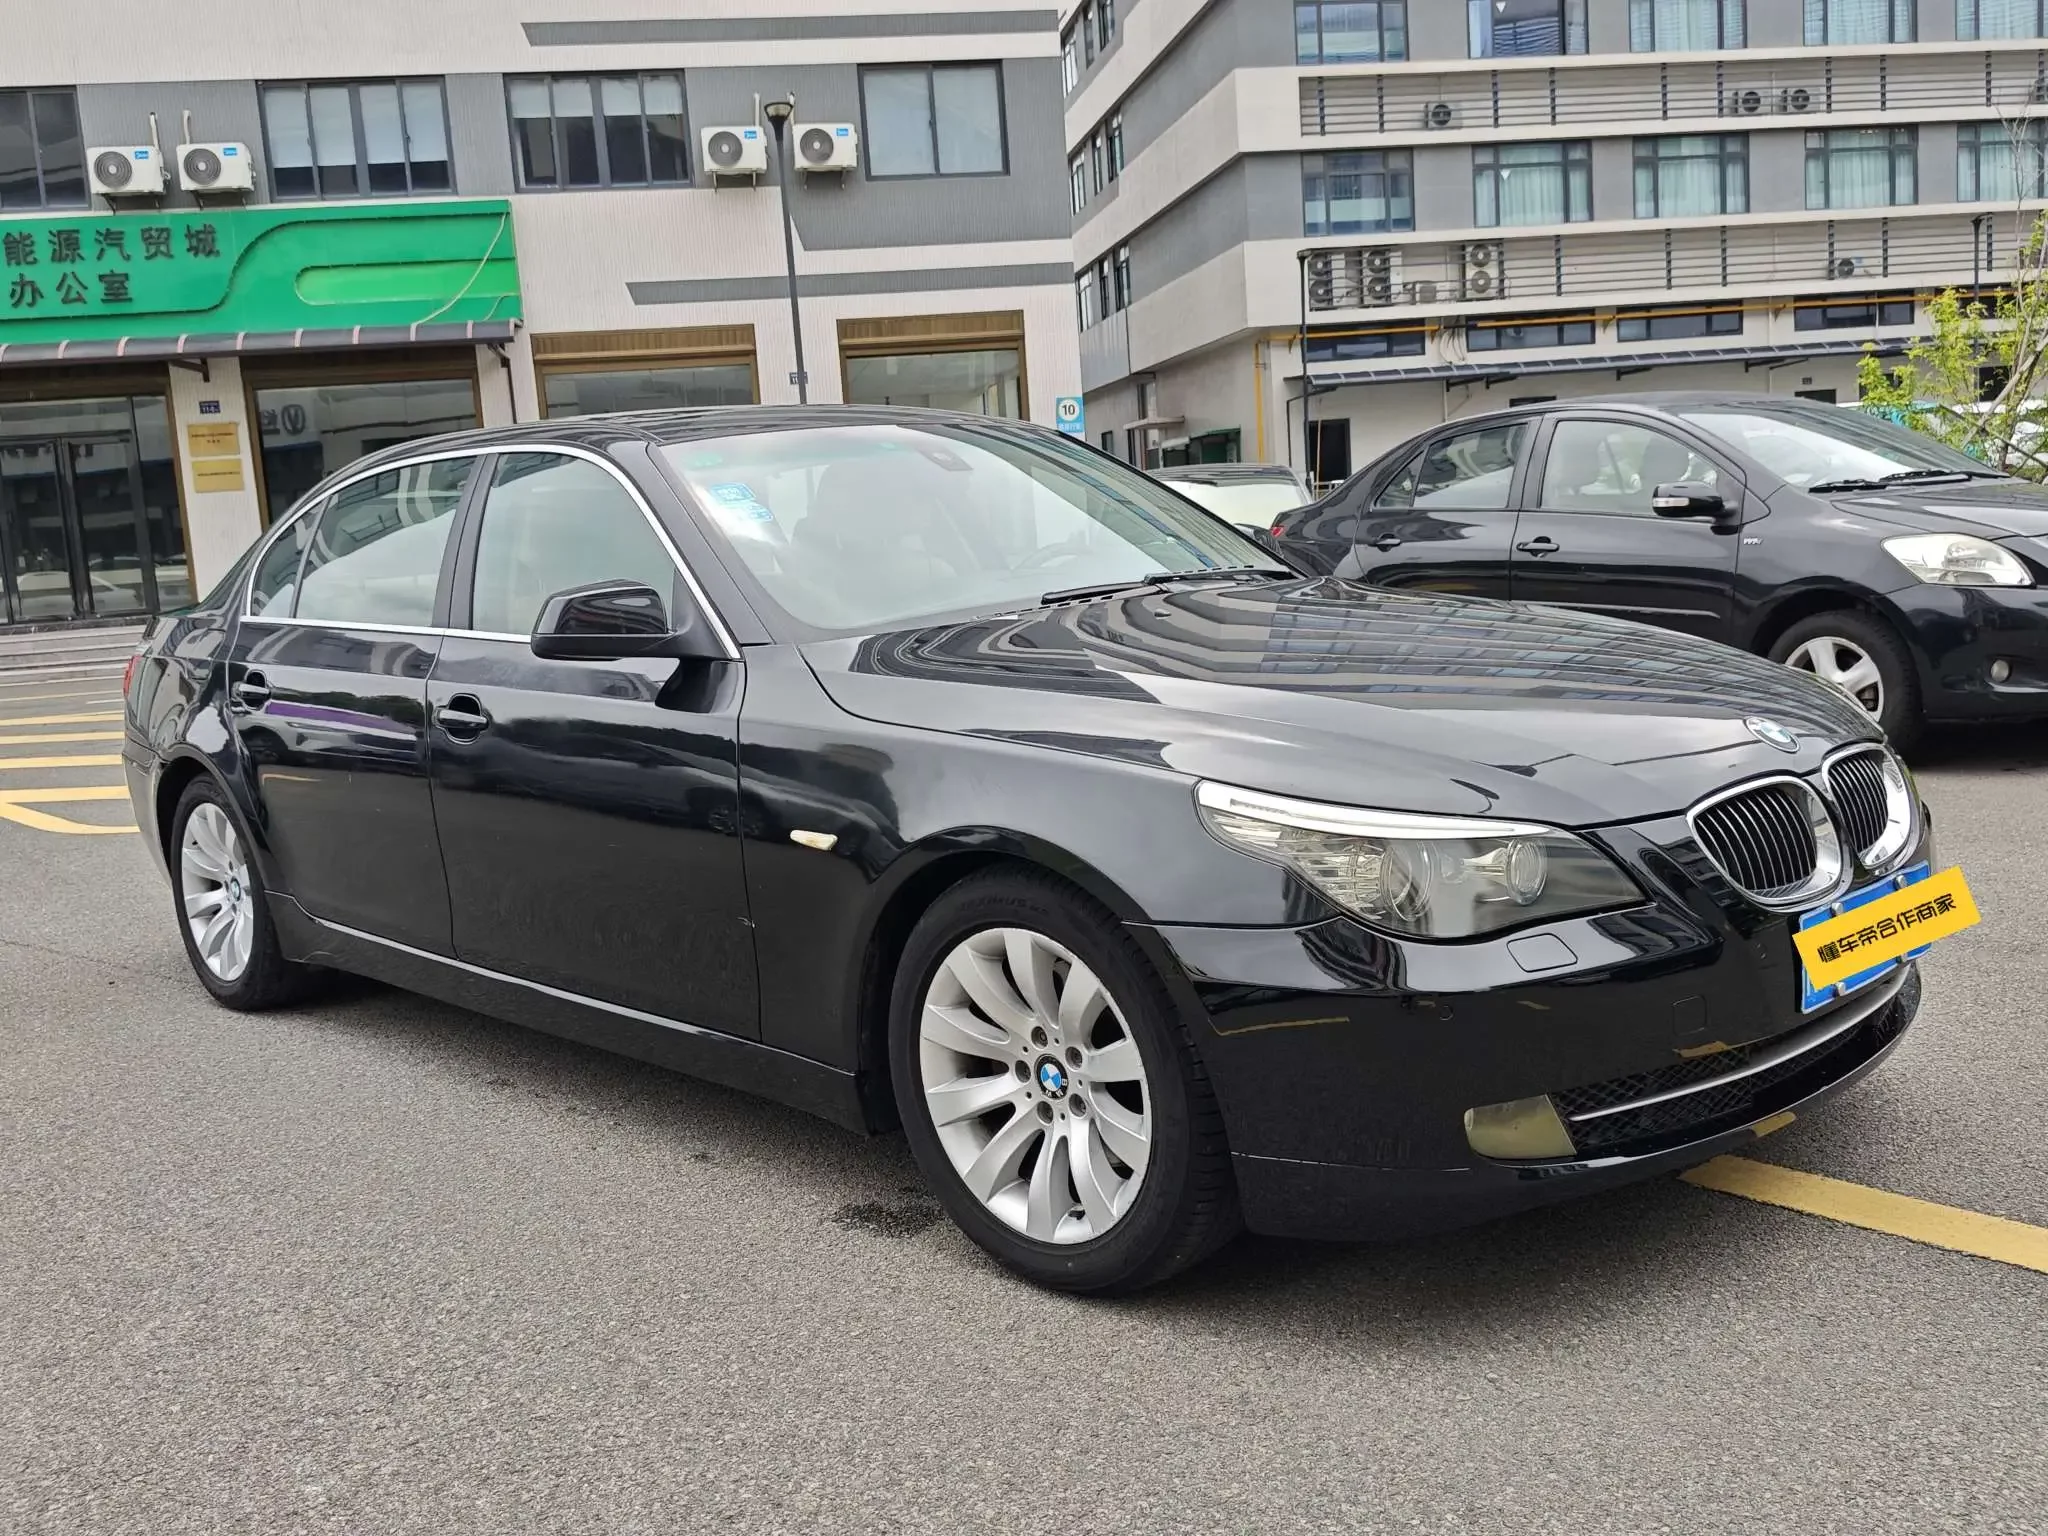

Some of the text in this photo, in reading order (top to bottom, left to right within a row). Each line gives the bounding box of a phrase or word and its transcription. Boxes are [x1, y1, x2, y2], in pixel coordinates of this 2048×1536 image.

[3, 223, 220, 267] 能源汽贸城
[10, 269, 133, 308] 办公室
[1062, 404, 1076, 416] 10
